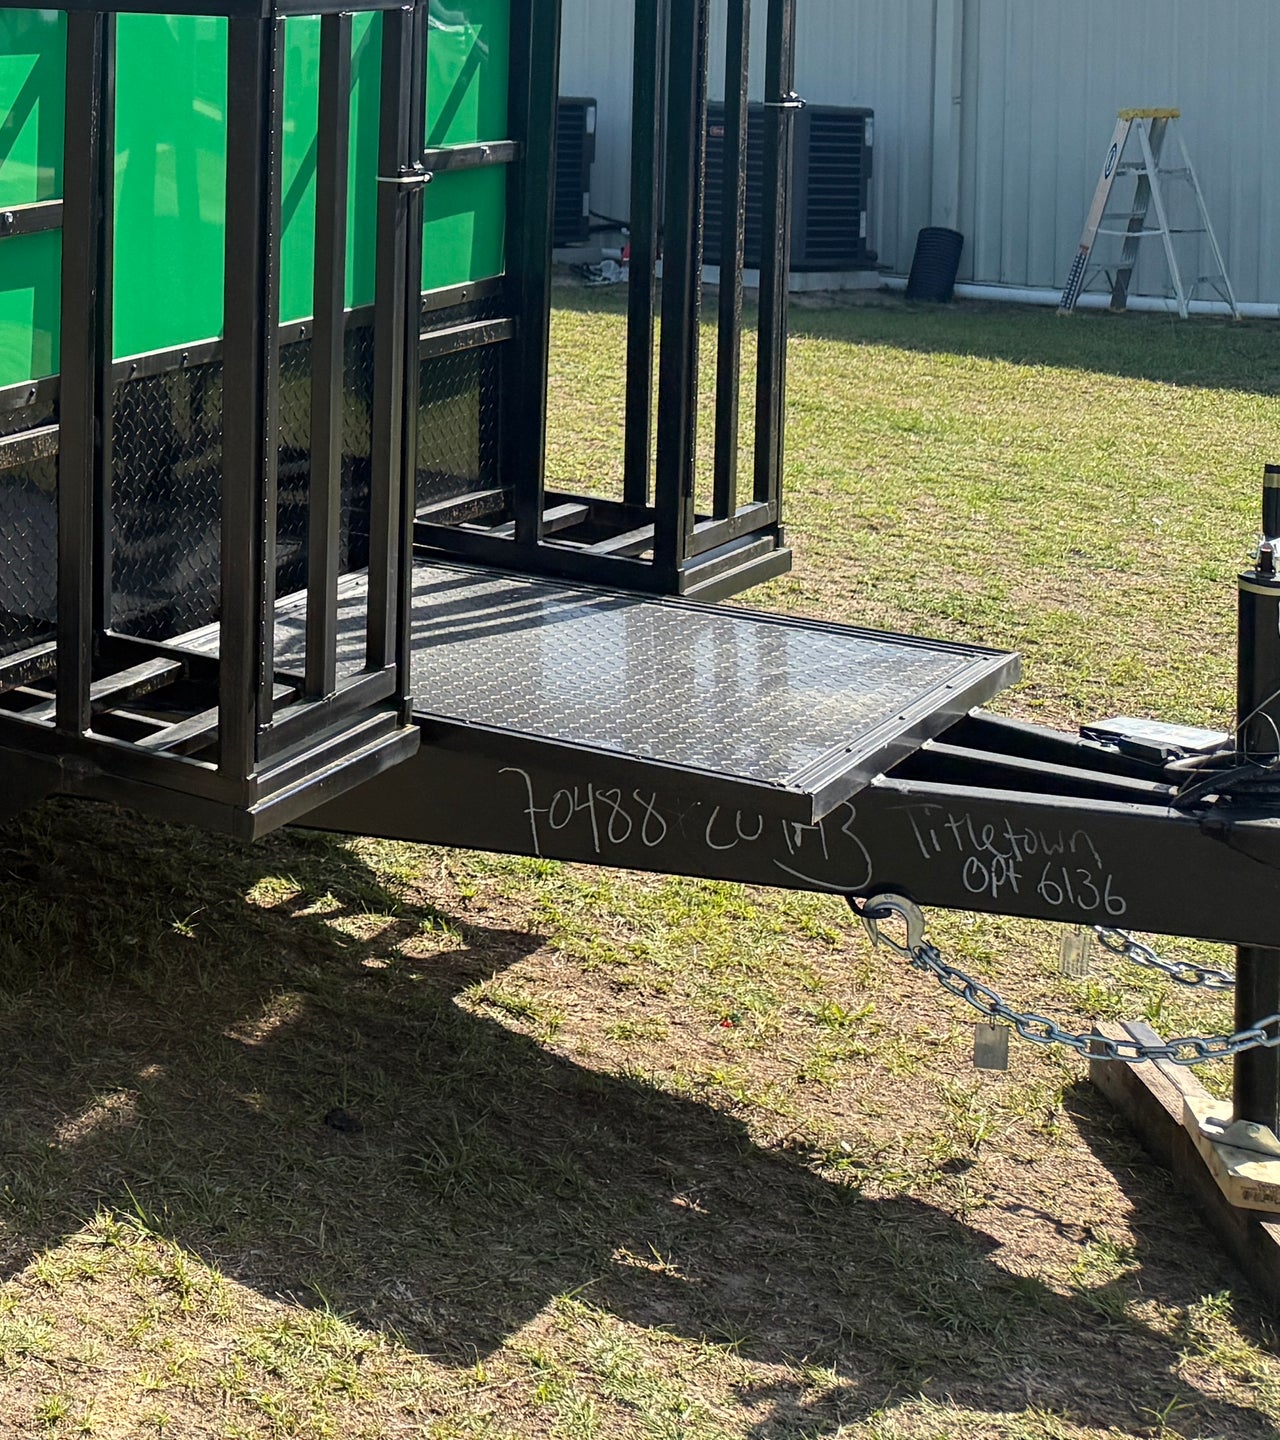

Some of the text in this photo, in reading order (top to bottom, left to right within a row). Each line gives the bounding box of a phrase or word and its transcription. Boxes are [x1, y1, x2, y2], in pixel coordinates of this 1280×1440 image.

[498, 767, 667, 857] 70488
[889, 803, 1102, 869] Titletown
[1037, 861, 1127, 915] 6136
